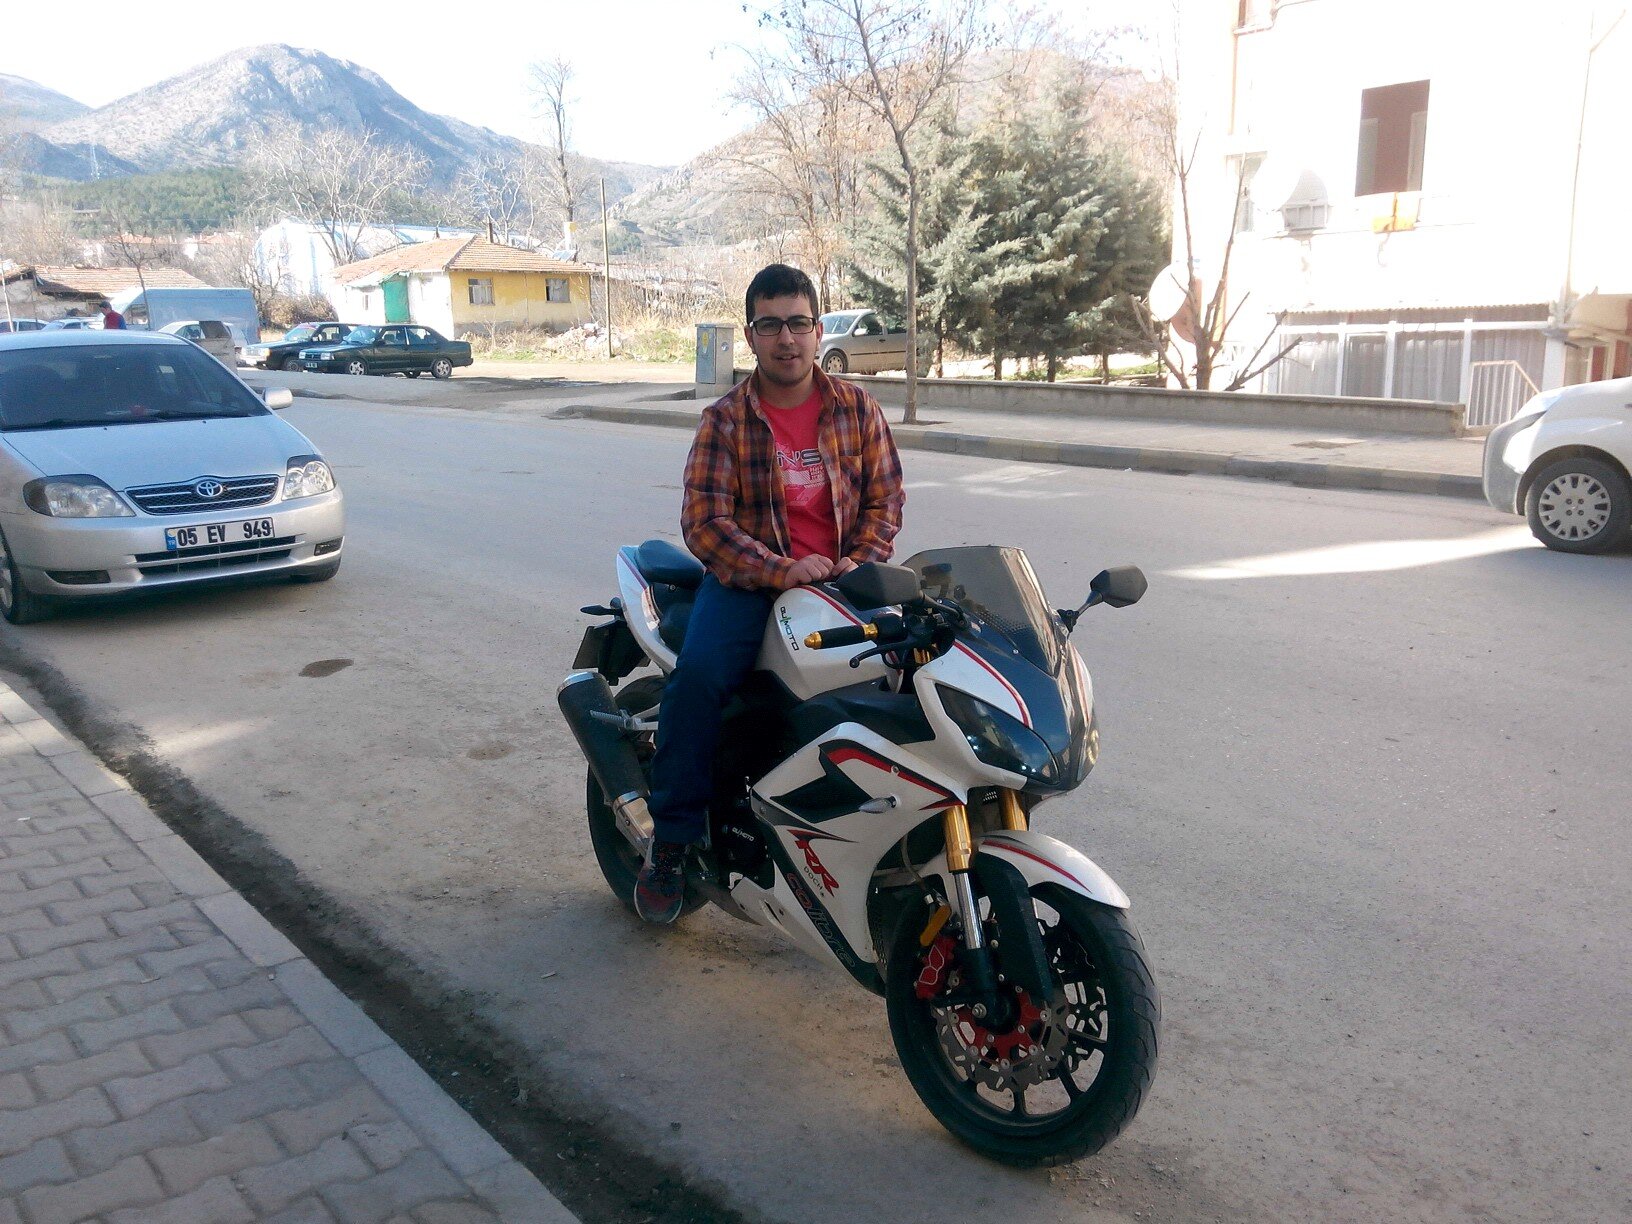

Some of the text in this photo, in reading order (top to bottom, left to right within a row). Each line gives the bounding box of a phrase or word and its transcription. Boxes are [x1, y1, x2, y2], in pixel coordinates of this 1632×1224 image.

[177, 520, 271, 547] 05 EV 949
